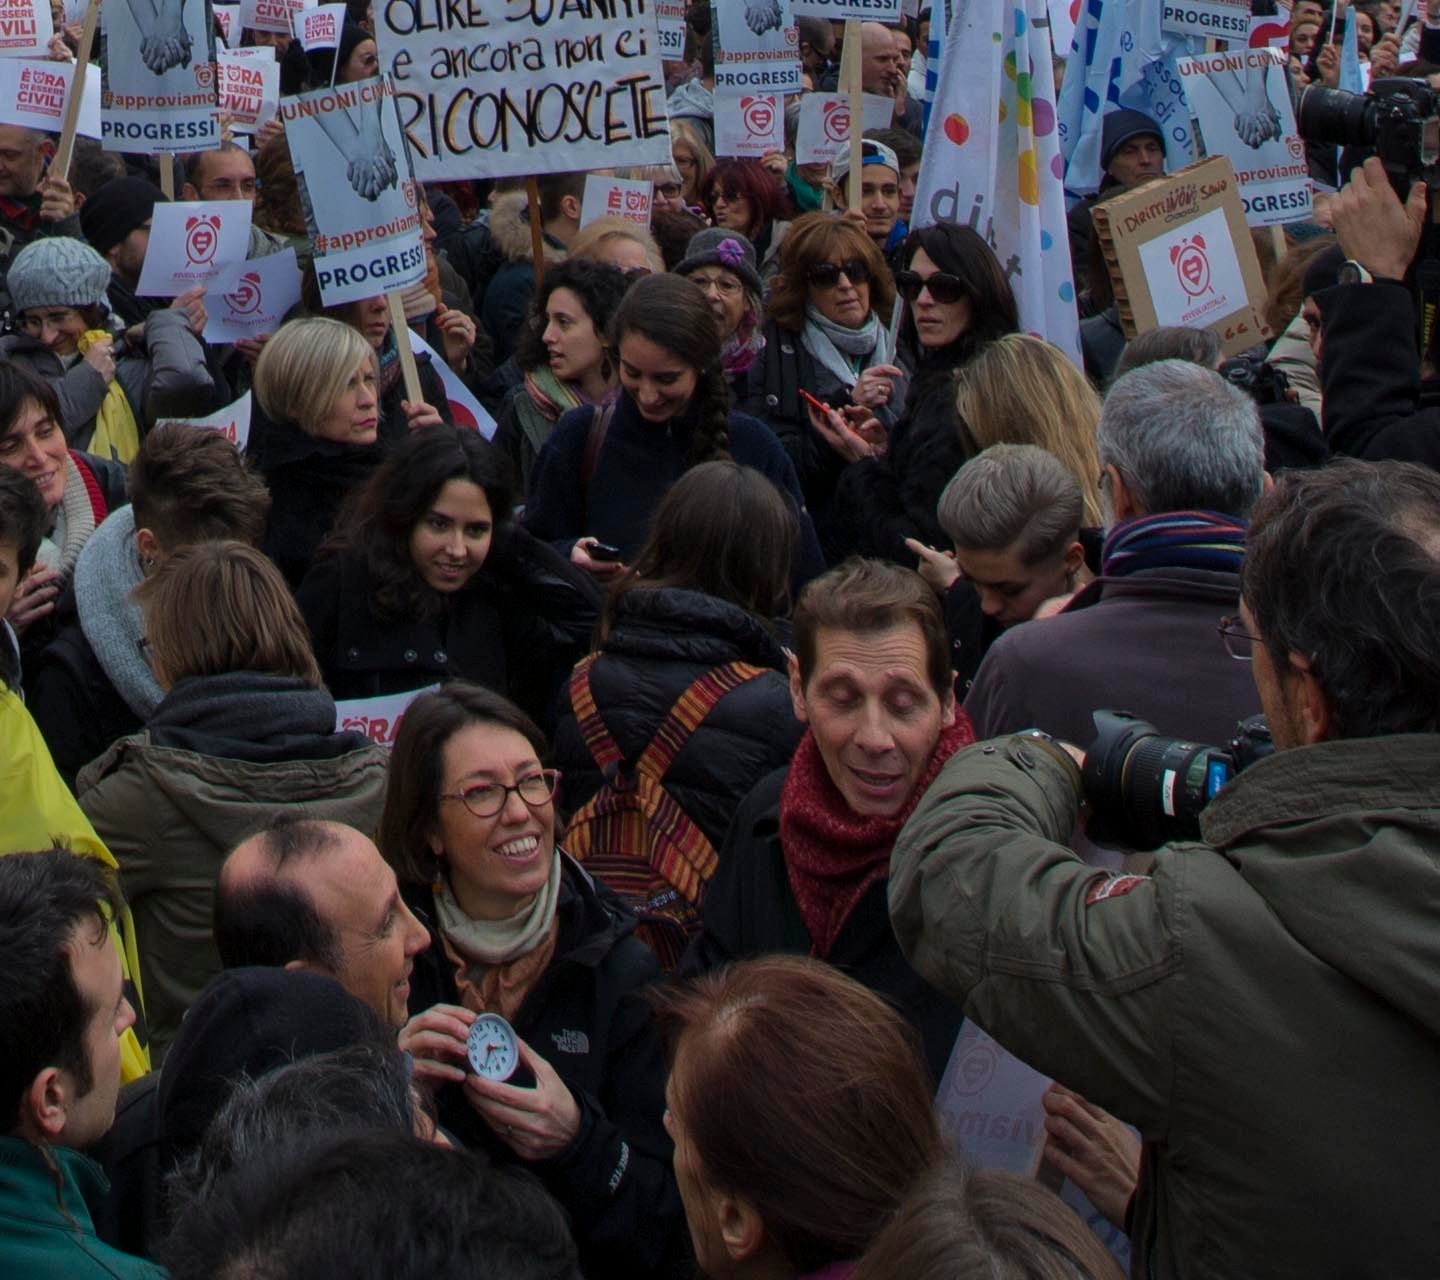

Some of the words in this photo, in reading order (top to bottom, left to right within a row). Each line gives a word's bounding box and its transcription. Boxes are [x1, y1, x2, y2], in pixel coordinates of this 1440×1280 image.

[1163, 6, 1249, 33] PROGRESSI
[393, 49, 413, 81] e
[429, 38, 546, 81] ancora
[554, 32, 605, 68] non
[618, 29, 648, 60] ci
[20, 67, 31, 82] È
[33, 70, 66, 87] ORA
[715, 67, 800, 86] PROGRESSI
[20, 82, 29, 90] DI
[31, 84, 66, 96] ESSERE
[17, 91, 64, 109] CIVILI
[104, 91, 218, 111] #approviamo
[282, 90, 358, 121] UNIONI
[393, 73, 671, 164] RICONOSCETE
[101, 120, 216, 140] PROGRESSI
[319, 244, 424, 291] PROGRESSI
